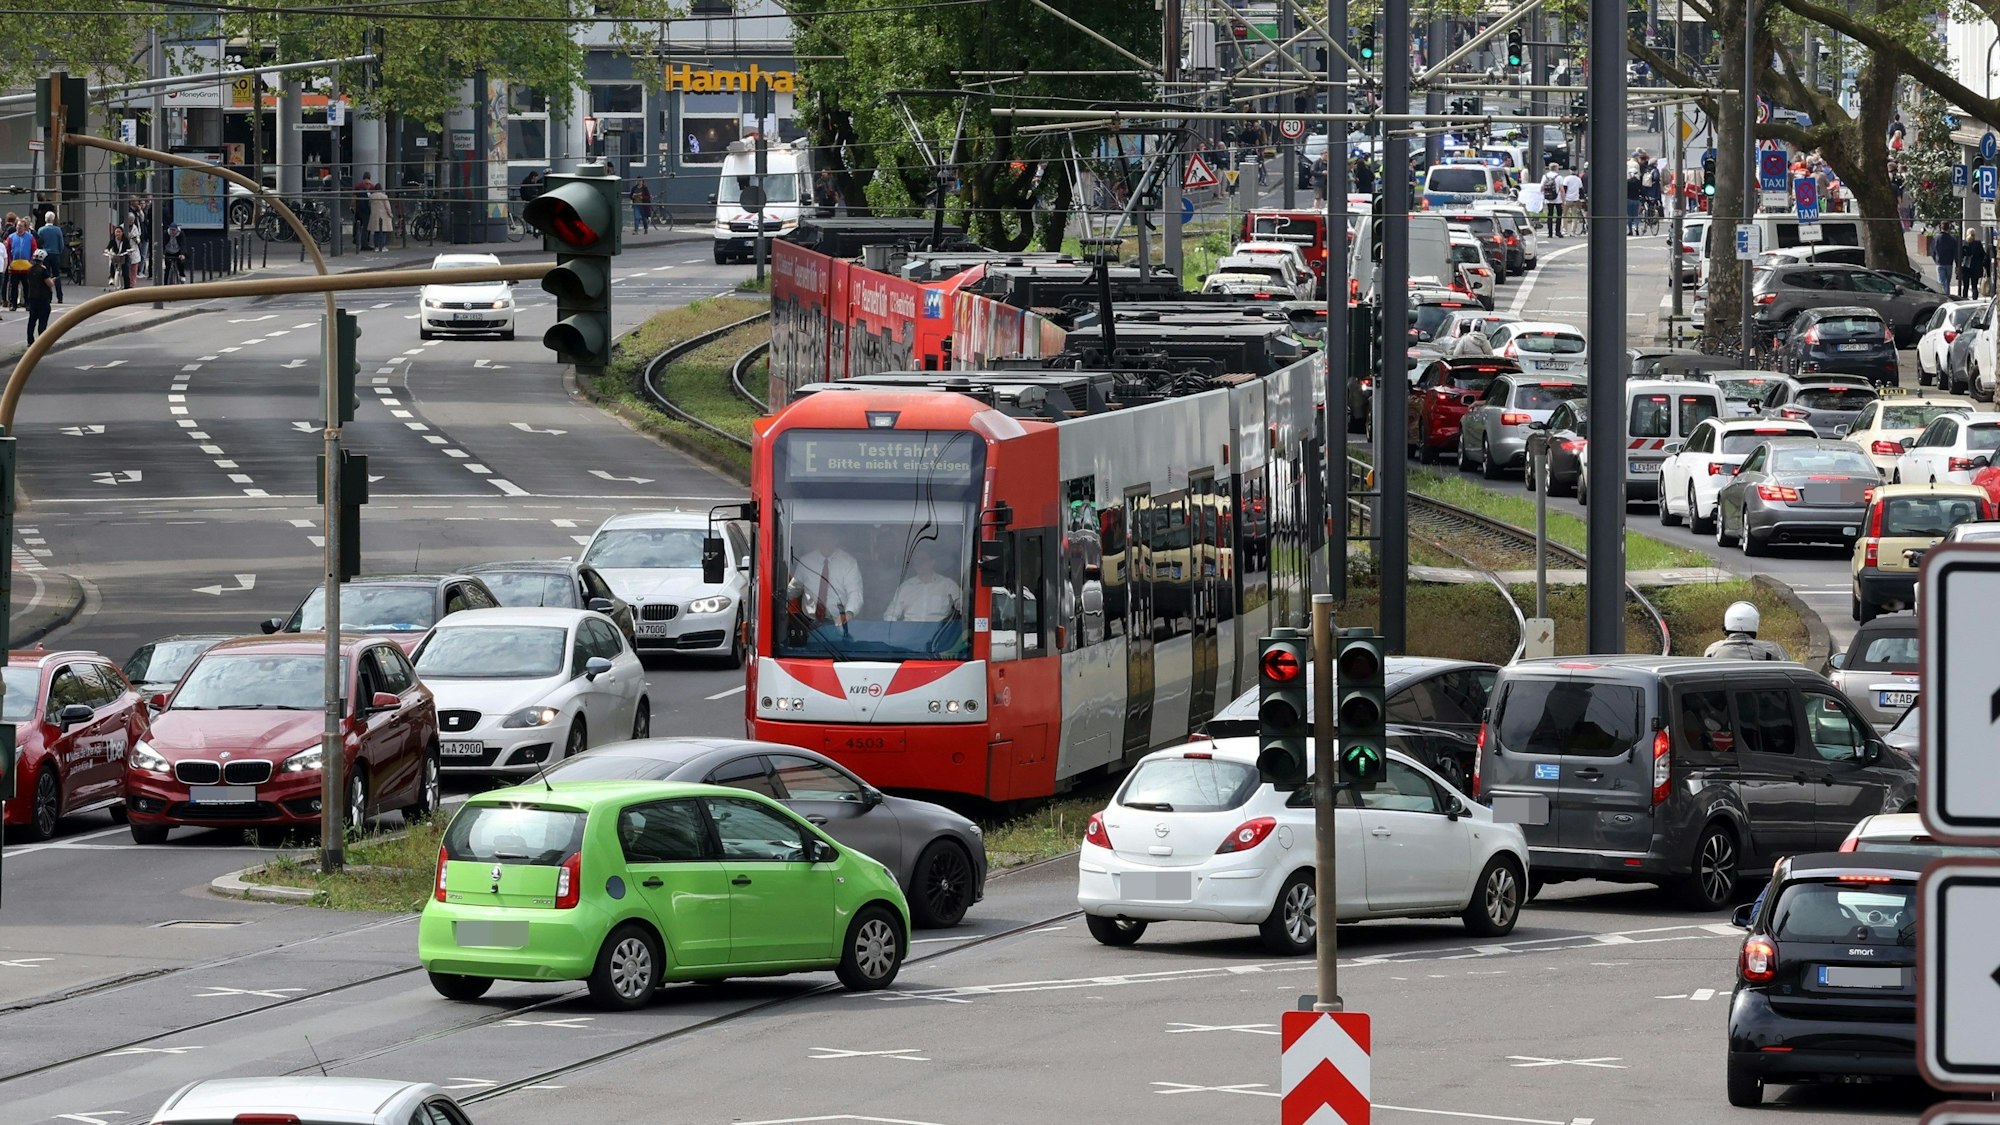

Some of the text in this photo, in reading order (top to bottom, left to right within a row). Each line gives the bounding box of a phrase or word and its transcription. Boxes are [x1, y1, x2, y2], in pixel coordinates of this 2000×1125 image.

[179, 91, 219, 99] MoneyGram
[1285, 121, 1299, 132] 30
[1954, 166, 1964, 183] P
[1763, 178, 1785, 188] TAXI
[1982, 171, 1993, 195] P
[1799, 208, 1818, 219] TAXI
[858, 443, 940, 457] Testfahrt
[805, 441, 817, 473] E
[828, 458, 970, 472] Bitte nicht einsteigen
[849, 686, 868, 694] KVB
[1885, 693, 1912, 704] K AB
[459, 743, 481, 754] 2900
[846, 738, 884, 748] 4503
[106, 739, 125, 763] Uber
[1848, 948, 1874, 956] smart
